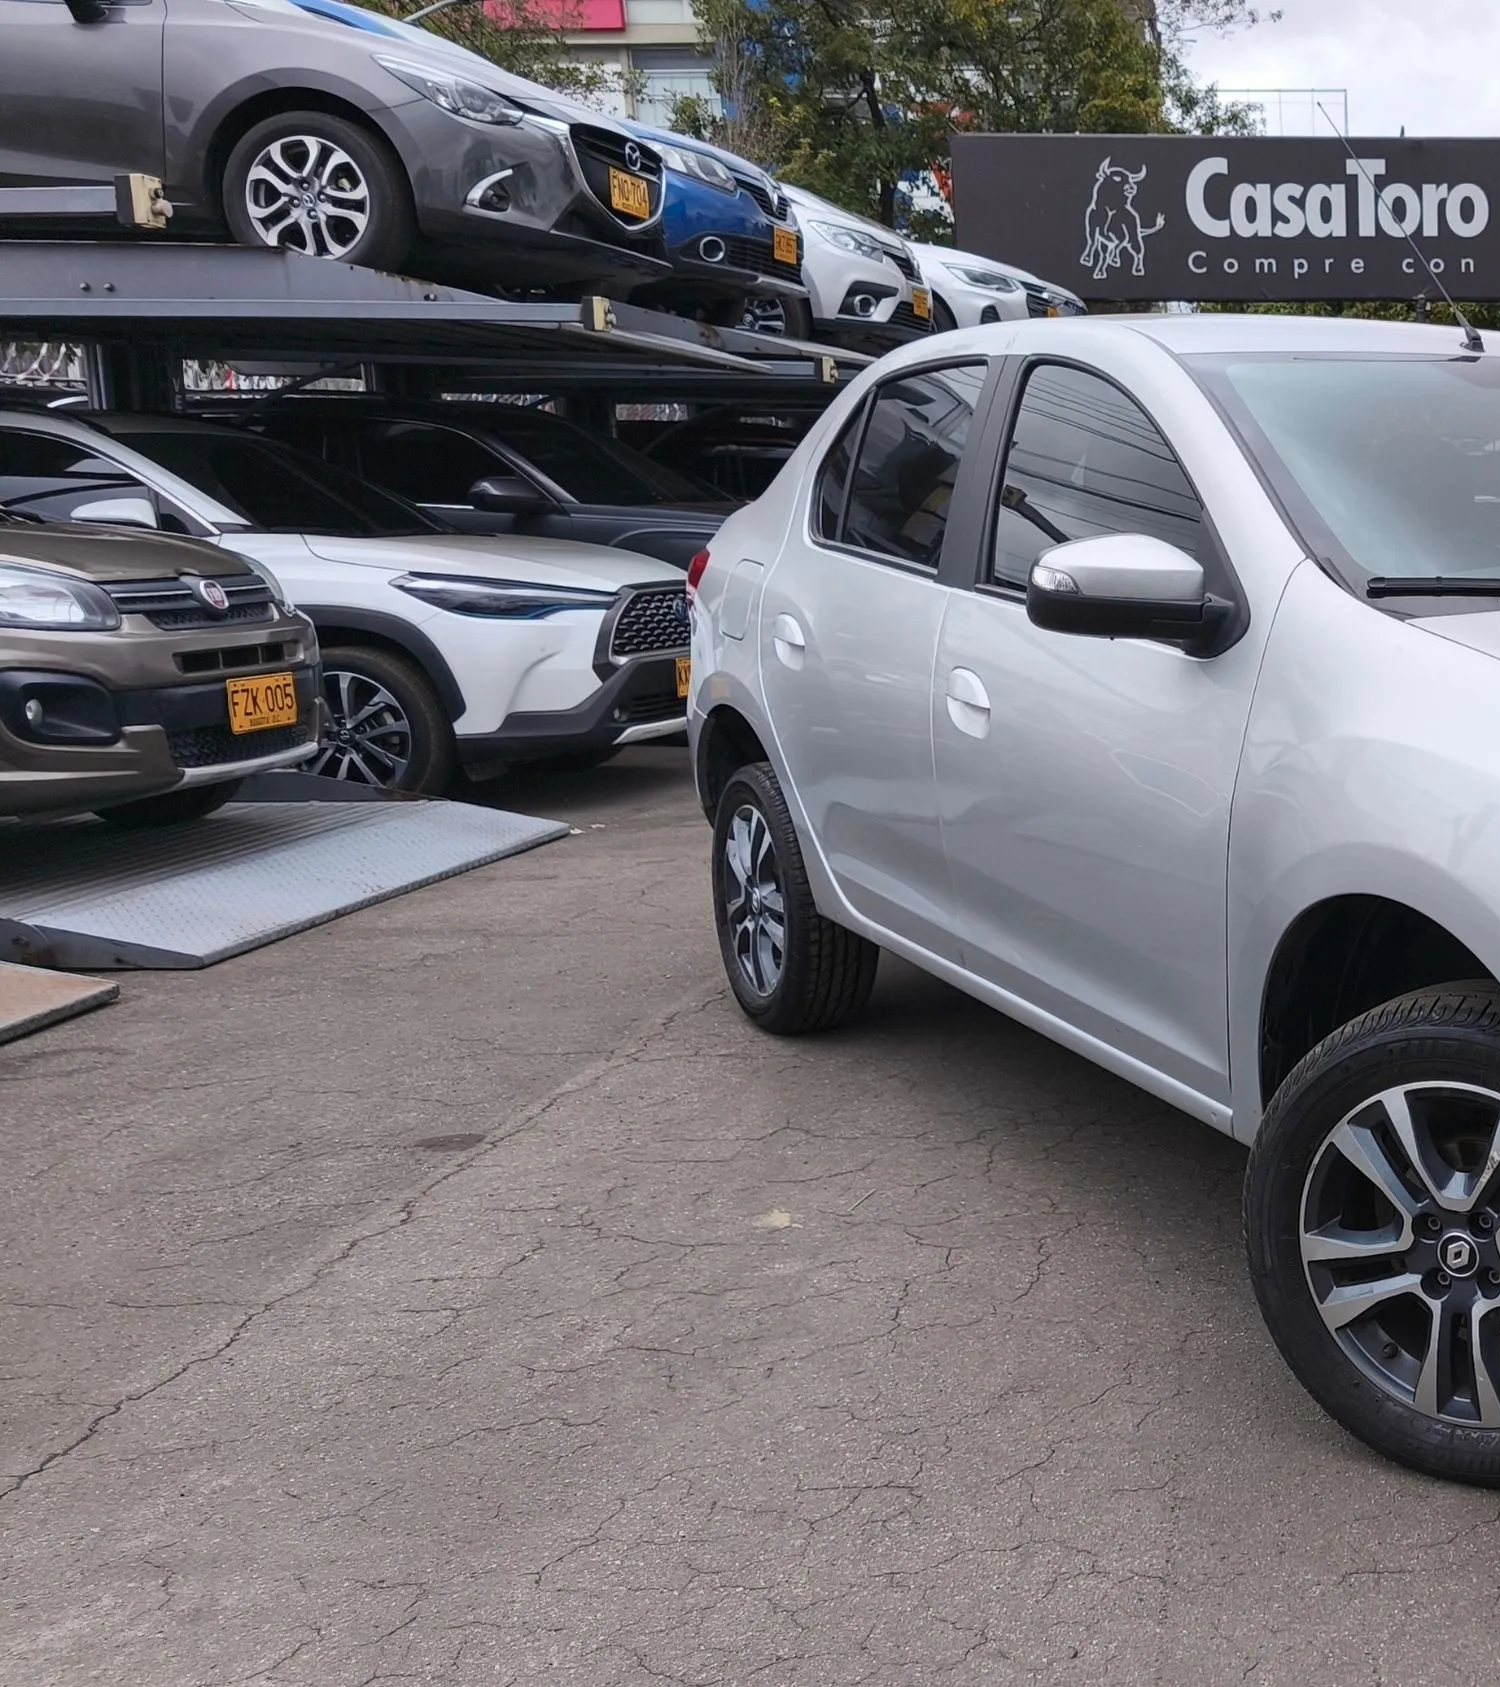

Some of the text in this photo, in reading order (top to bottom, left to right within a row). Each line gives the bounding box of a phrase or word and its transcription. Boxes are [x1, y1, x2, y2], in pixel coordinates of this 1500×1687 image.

[1186, 156, 1490, 238] CasaToro
[1187, 251, 1365, 279] Compre
[1401, 257, 1475, 274] con
[265, 683, 294, 712] 005
